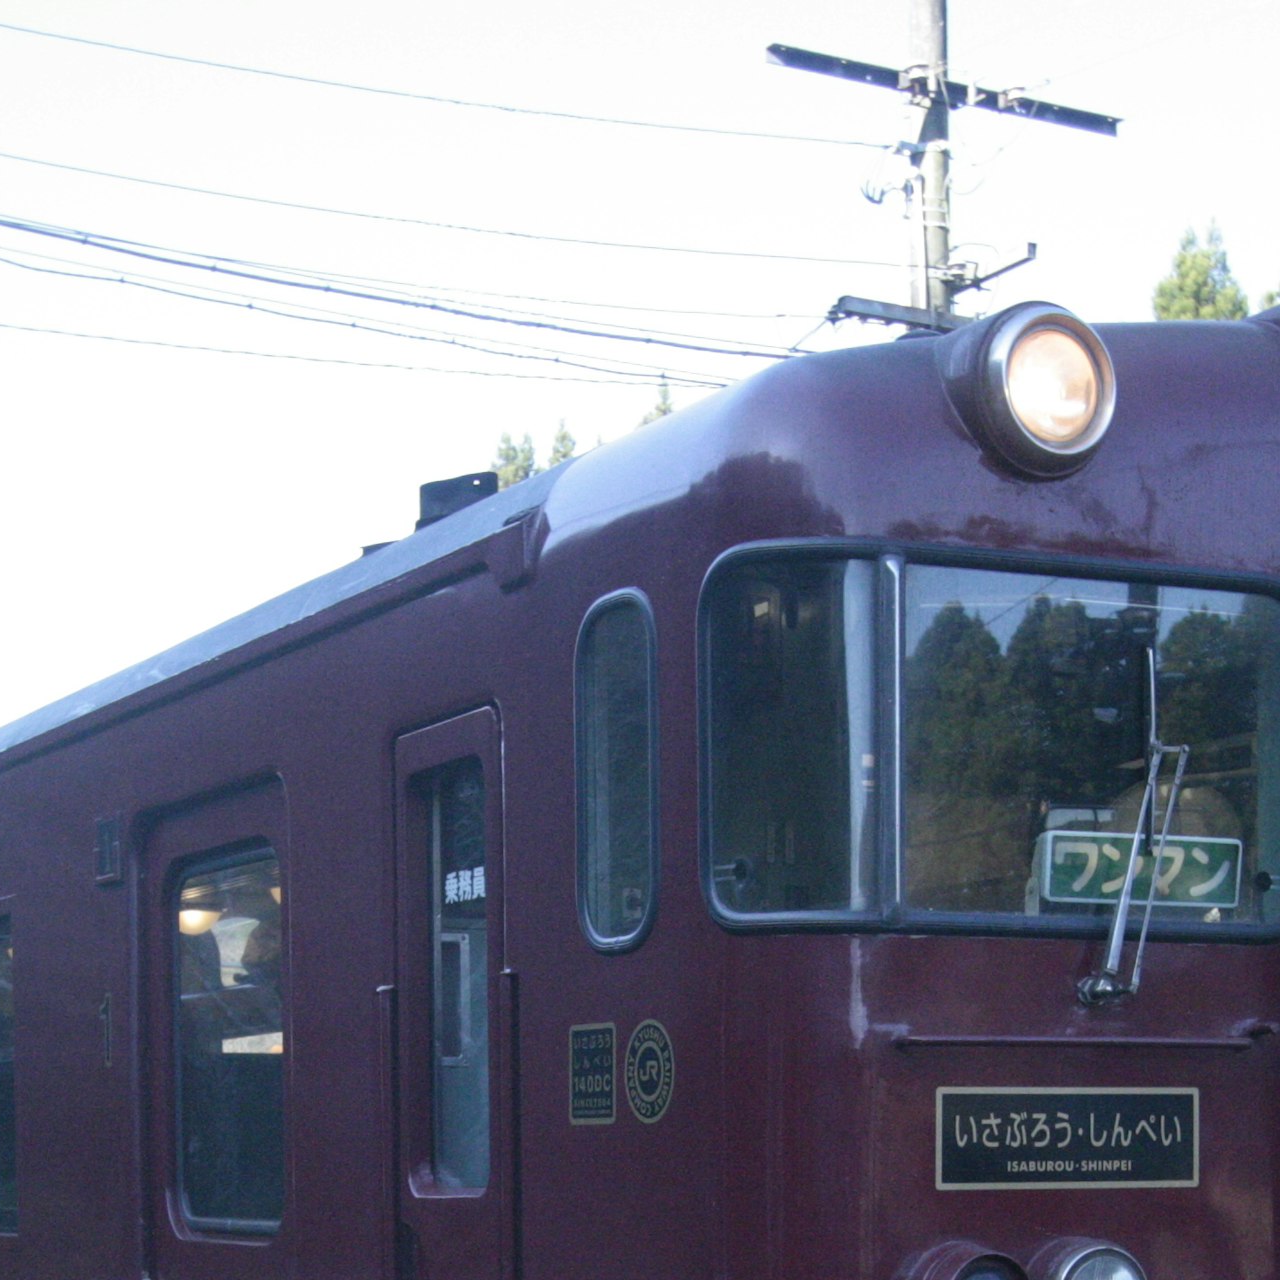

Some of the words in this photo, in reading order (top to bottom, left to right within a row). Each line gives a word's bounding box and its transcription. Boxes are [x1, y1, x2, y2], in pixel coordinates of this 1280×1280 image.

[445, 866, 486, 904] 乗務員
[1055, 842, 1230, 896] ワンマン
[574, 1074, 611, 1093] 140DC
[639, 1060, 658, 1081] JR
[955, 1112, 1181, 1148] いさぶろう・しんぺい
